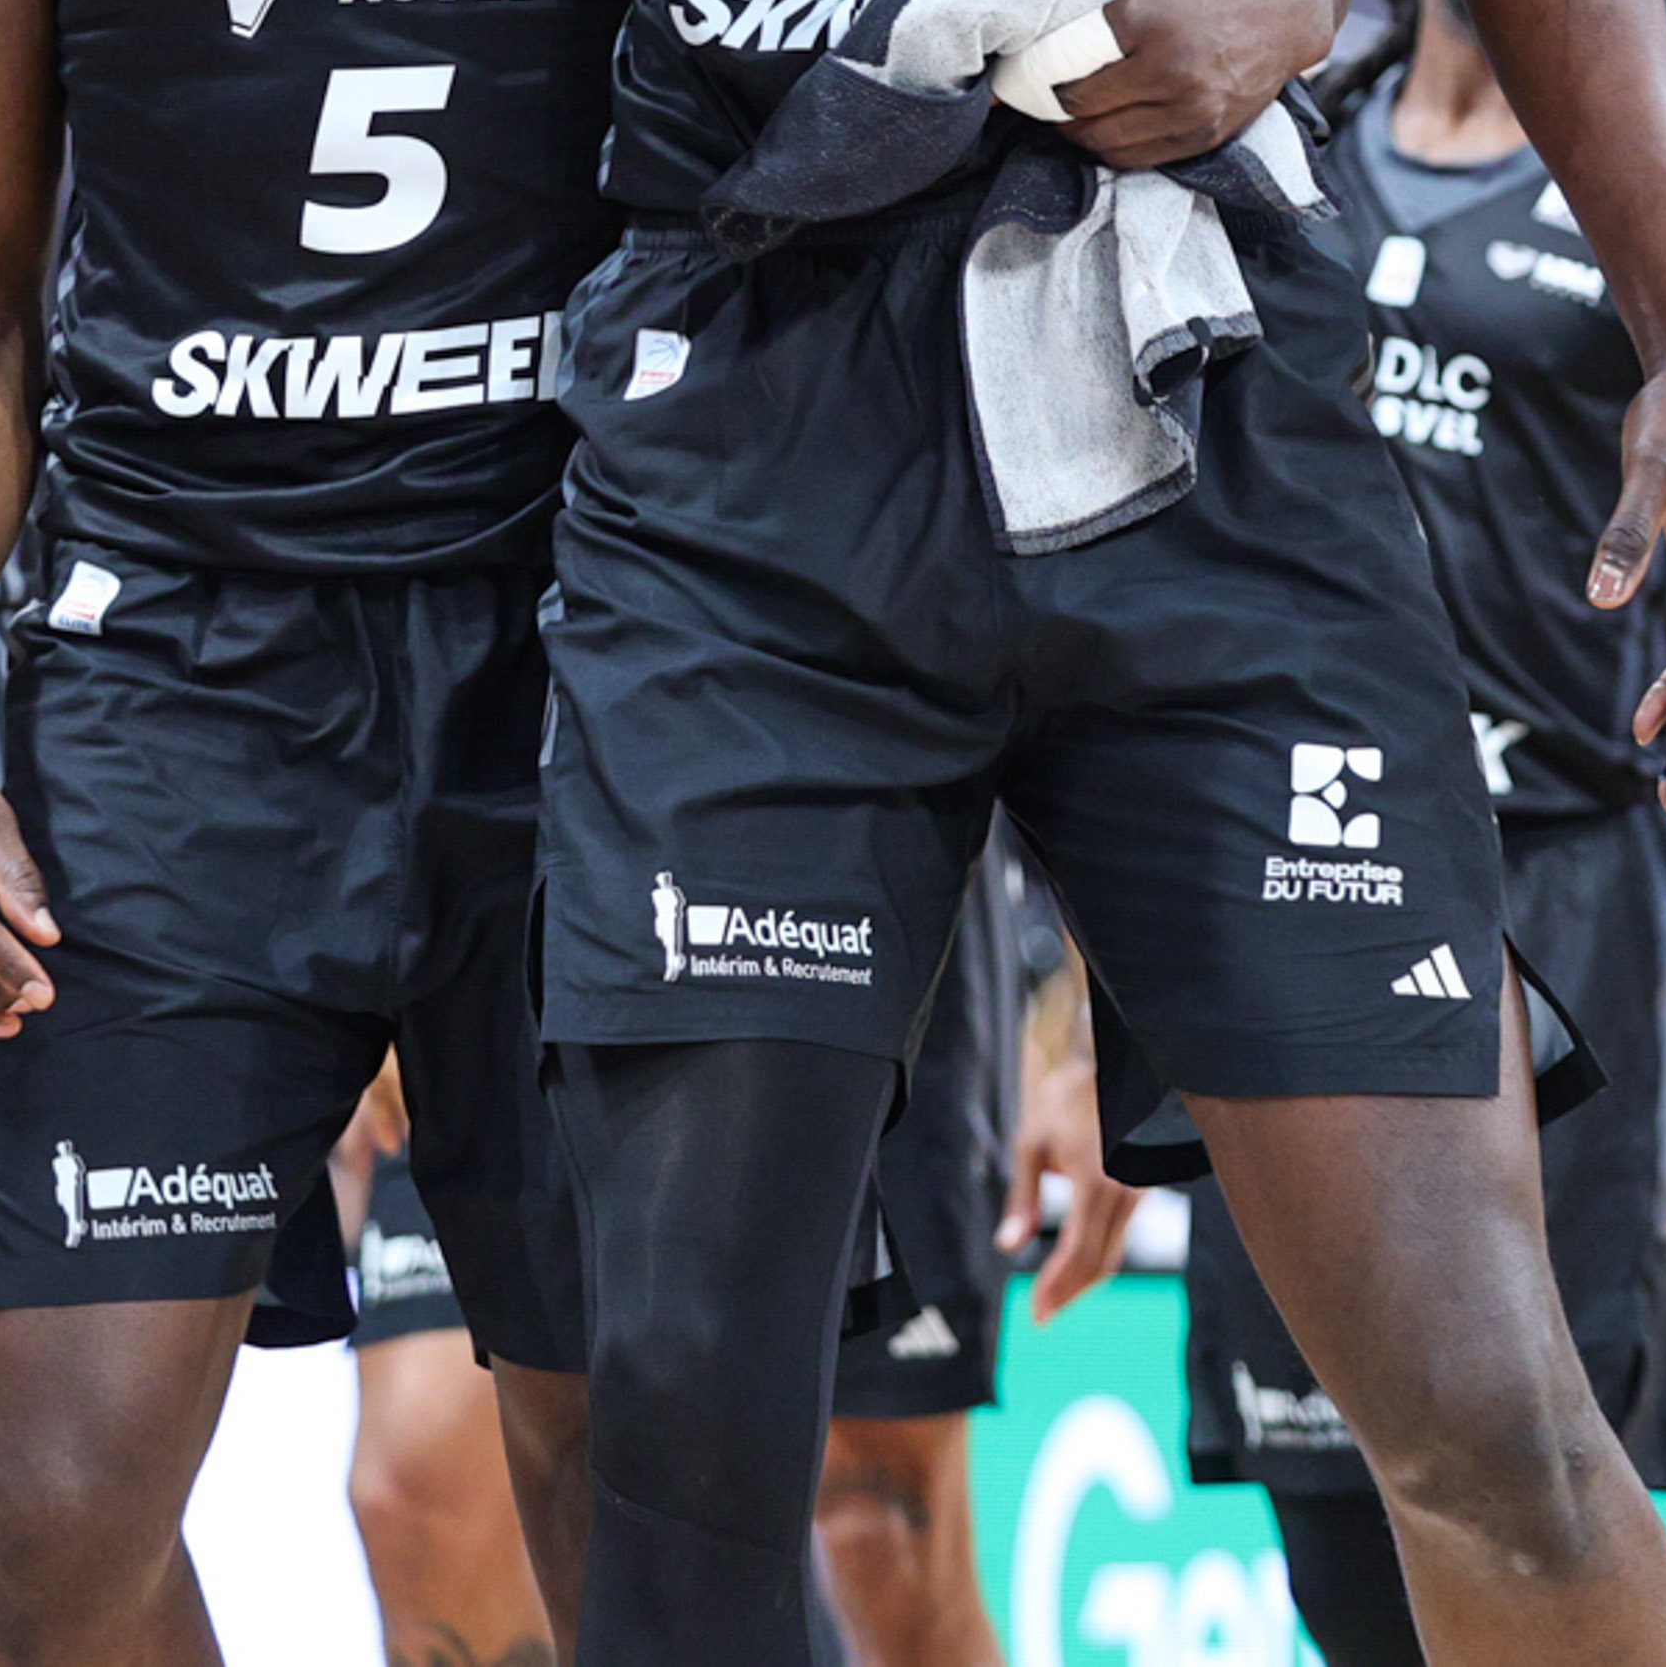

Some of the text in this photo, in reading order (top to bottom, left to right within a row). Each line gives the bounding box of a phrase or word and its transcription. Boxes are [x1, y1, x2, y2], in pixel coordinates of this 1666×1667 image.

[301, 65, 455, 253] 5
[1374, 335, 1493, 411] DLC
[1371, 394, 1484, 456] SVEL
[1263, 879, 1402, 905] DU FUTUR
[1265, 857, 1403, 882] Entreprise
[725, 905, 873, 956] Adéquat
[691, 954, 872, 985] Intérim & Recrutement
[129, 1164, 277, 1209] Adéquat
[92, 1208, 275, 1239] Intérim & Recrutement
